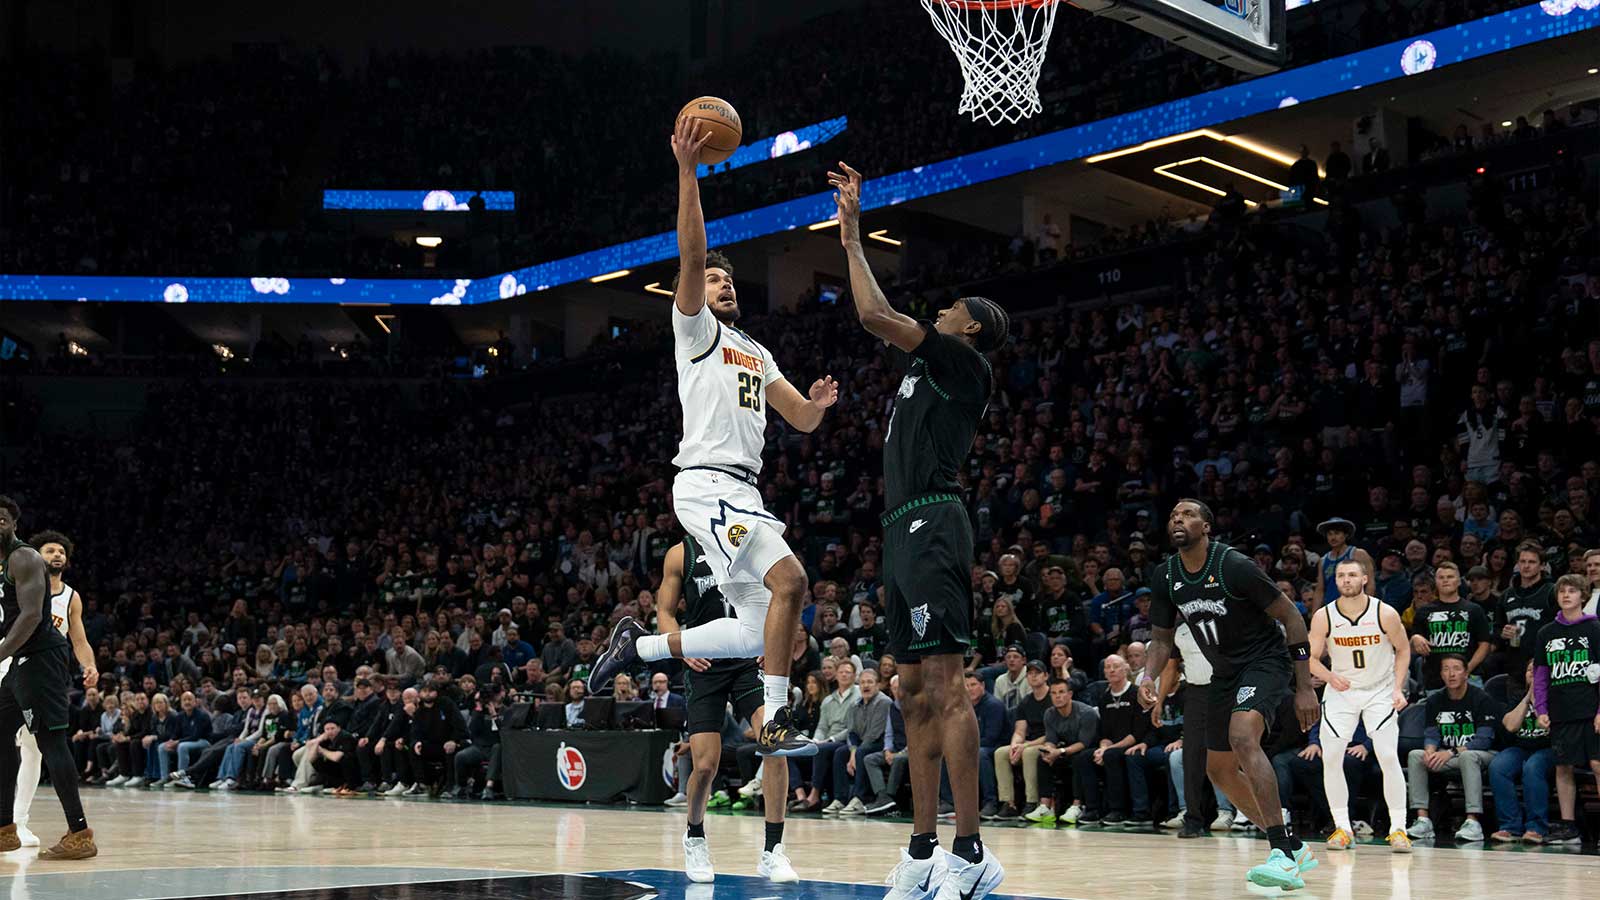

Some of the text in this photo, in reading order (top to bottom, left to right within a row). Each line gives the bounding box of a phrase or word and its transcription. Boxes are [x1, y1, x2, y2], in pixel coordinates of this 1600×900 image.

[1508, 172, 1537, 192] 111
[1097, 268, 1121, 285] 110
[737, 372, 762, 411] 23
[1195, 619, 1219, 646] 11
[1455, 621, 1468, 633] GO
[1333, 634, 1381, 647] NUGGETS
[1298, 647, 1306, 656] 11
[1352, 649, 1366, 669] 0
[1574, 649, 1589, 662] GO
[1441, 723, 1475, 737] ET'S GO
